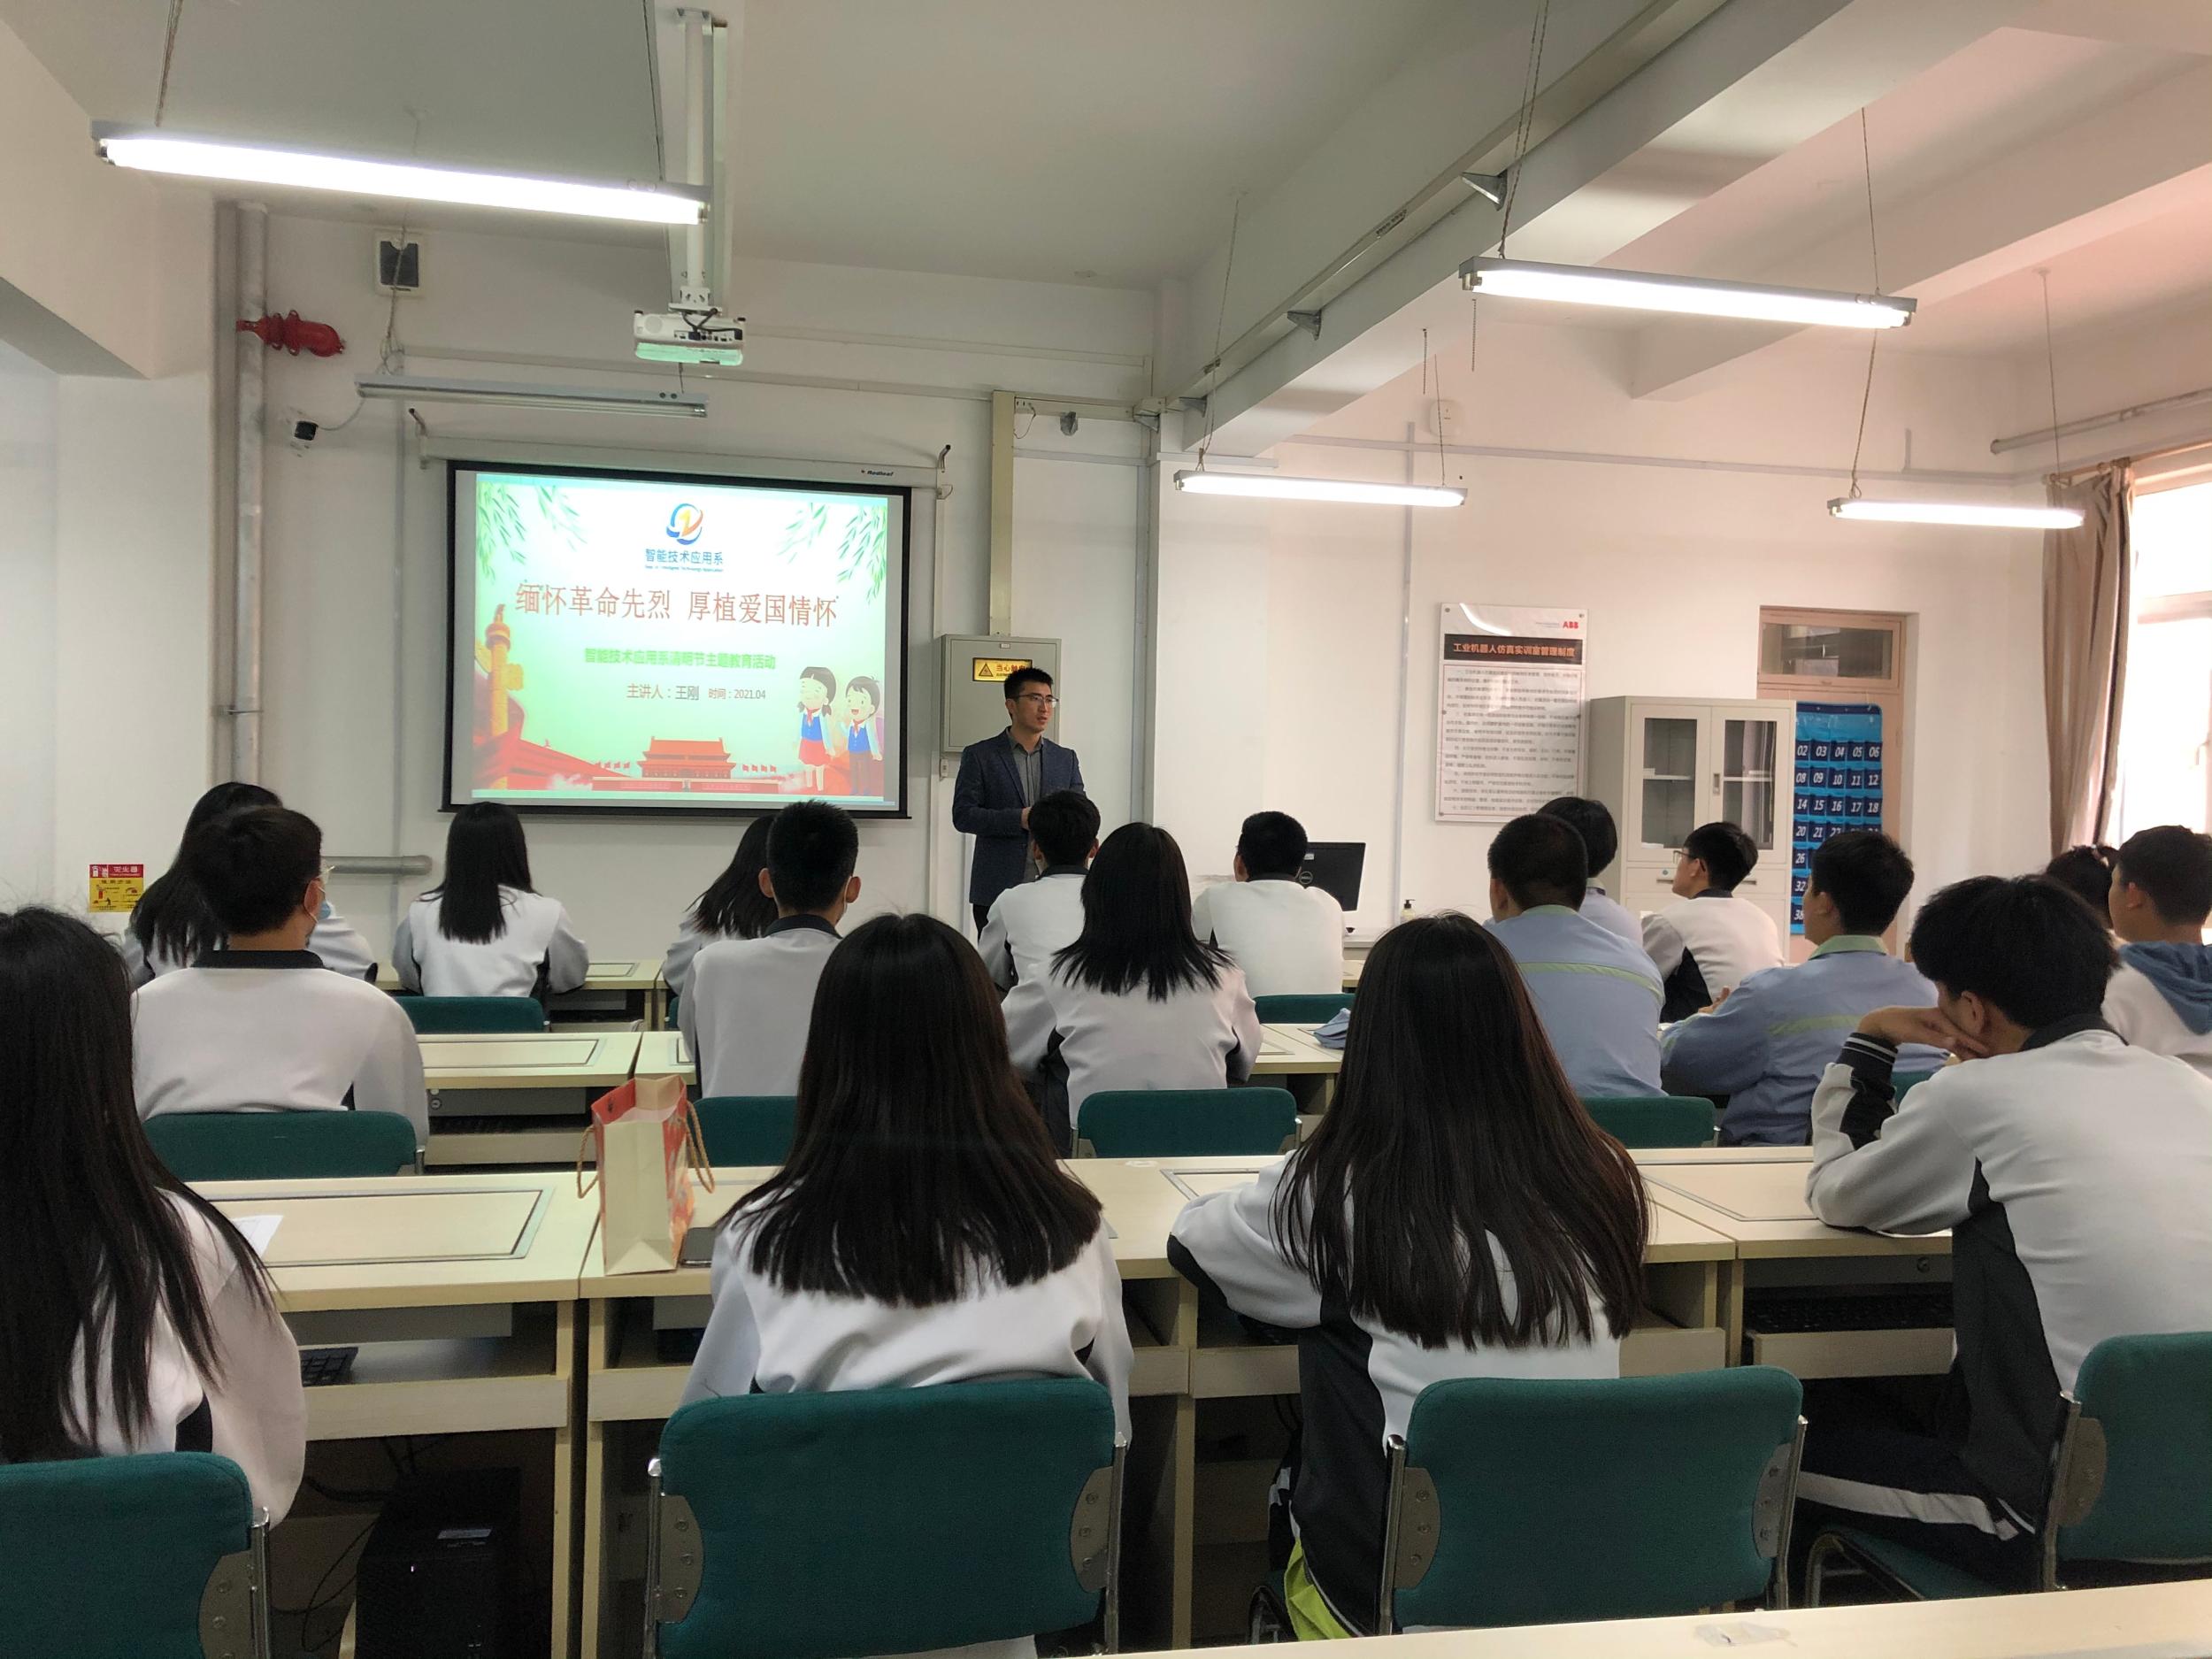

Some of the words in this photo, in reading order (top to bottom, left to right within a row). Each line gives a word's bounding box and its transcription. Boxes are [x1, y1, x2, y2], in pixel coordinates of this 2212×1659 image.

[645, 548, 723, 565] 智能技术应用系
[515, 583, 670, 619] 缅怀革命先烈
[687, 591, 837, 627] 厚植爱国情怀
[585, 648, 776, 670] 智能技术应用系清明节主题教育活动
[1797, 746, 1808, 756] 02
[1816, 746, 1827, 757] 03
[1835, 747, 1845, 757] 04
[1853, 747, 1863, 757] 05
[1869, 747, 1880, 757] 06
[1796, 772, 1807, 783] 08
[1813, 772, 1824, 783] 09
[1832, 774, 1843, 786] 10
[1851, 776, 1861, 786] 11
[1869, 775, 1878, 786] 12
[1797, 799, 1808, 810] 14
[1814, 800, 1824, 810] 15
[1832, 801, 1842, 811] 16
[1851, 803, 1862, 812] 17
[1868, 803, 1879, 813] 18
[1796, 826, 1806, 837] 20
[1813, 827, 1823, 838] 21
[1795, 853, 1805, 864] 26
[1795, 881, 1806, 892] 32
